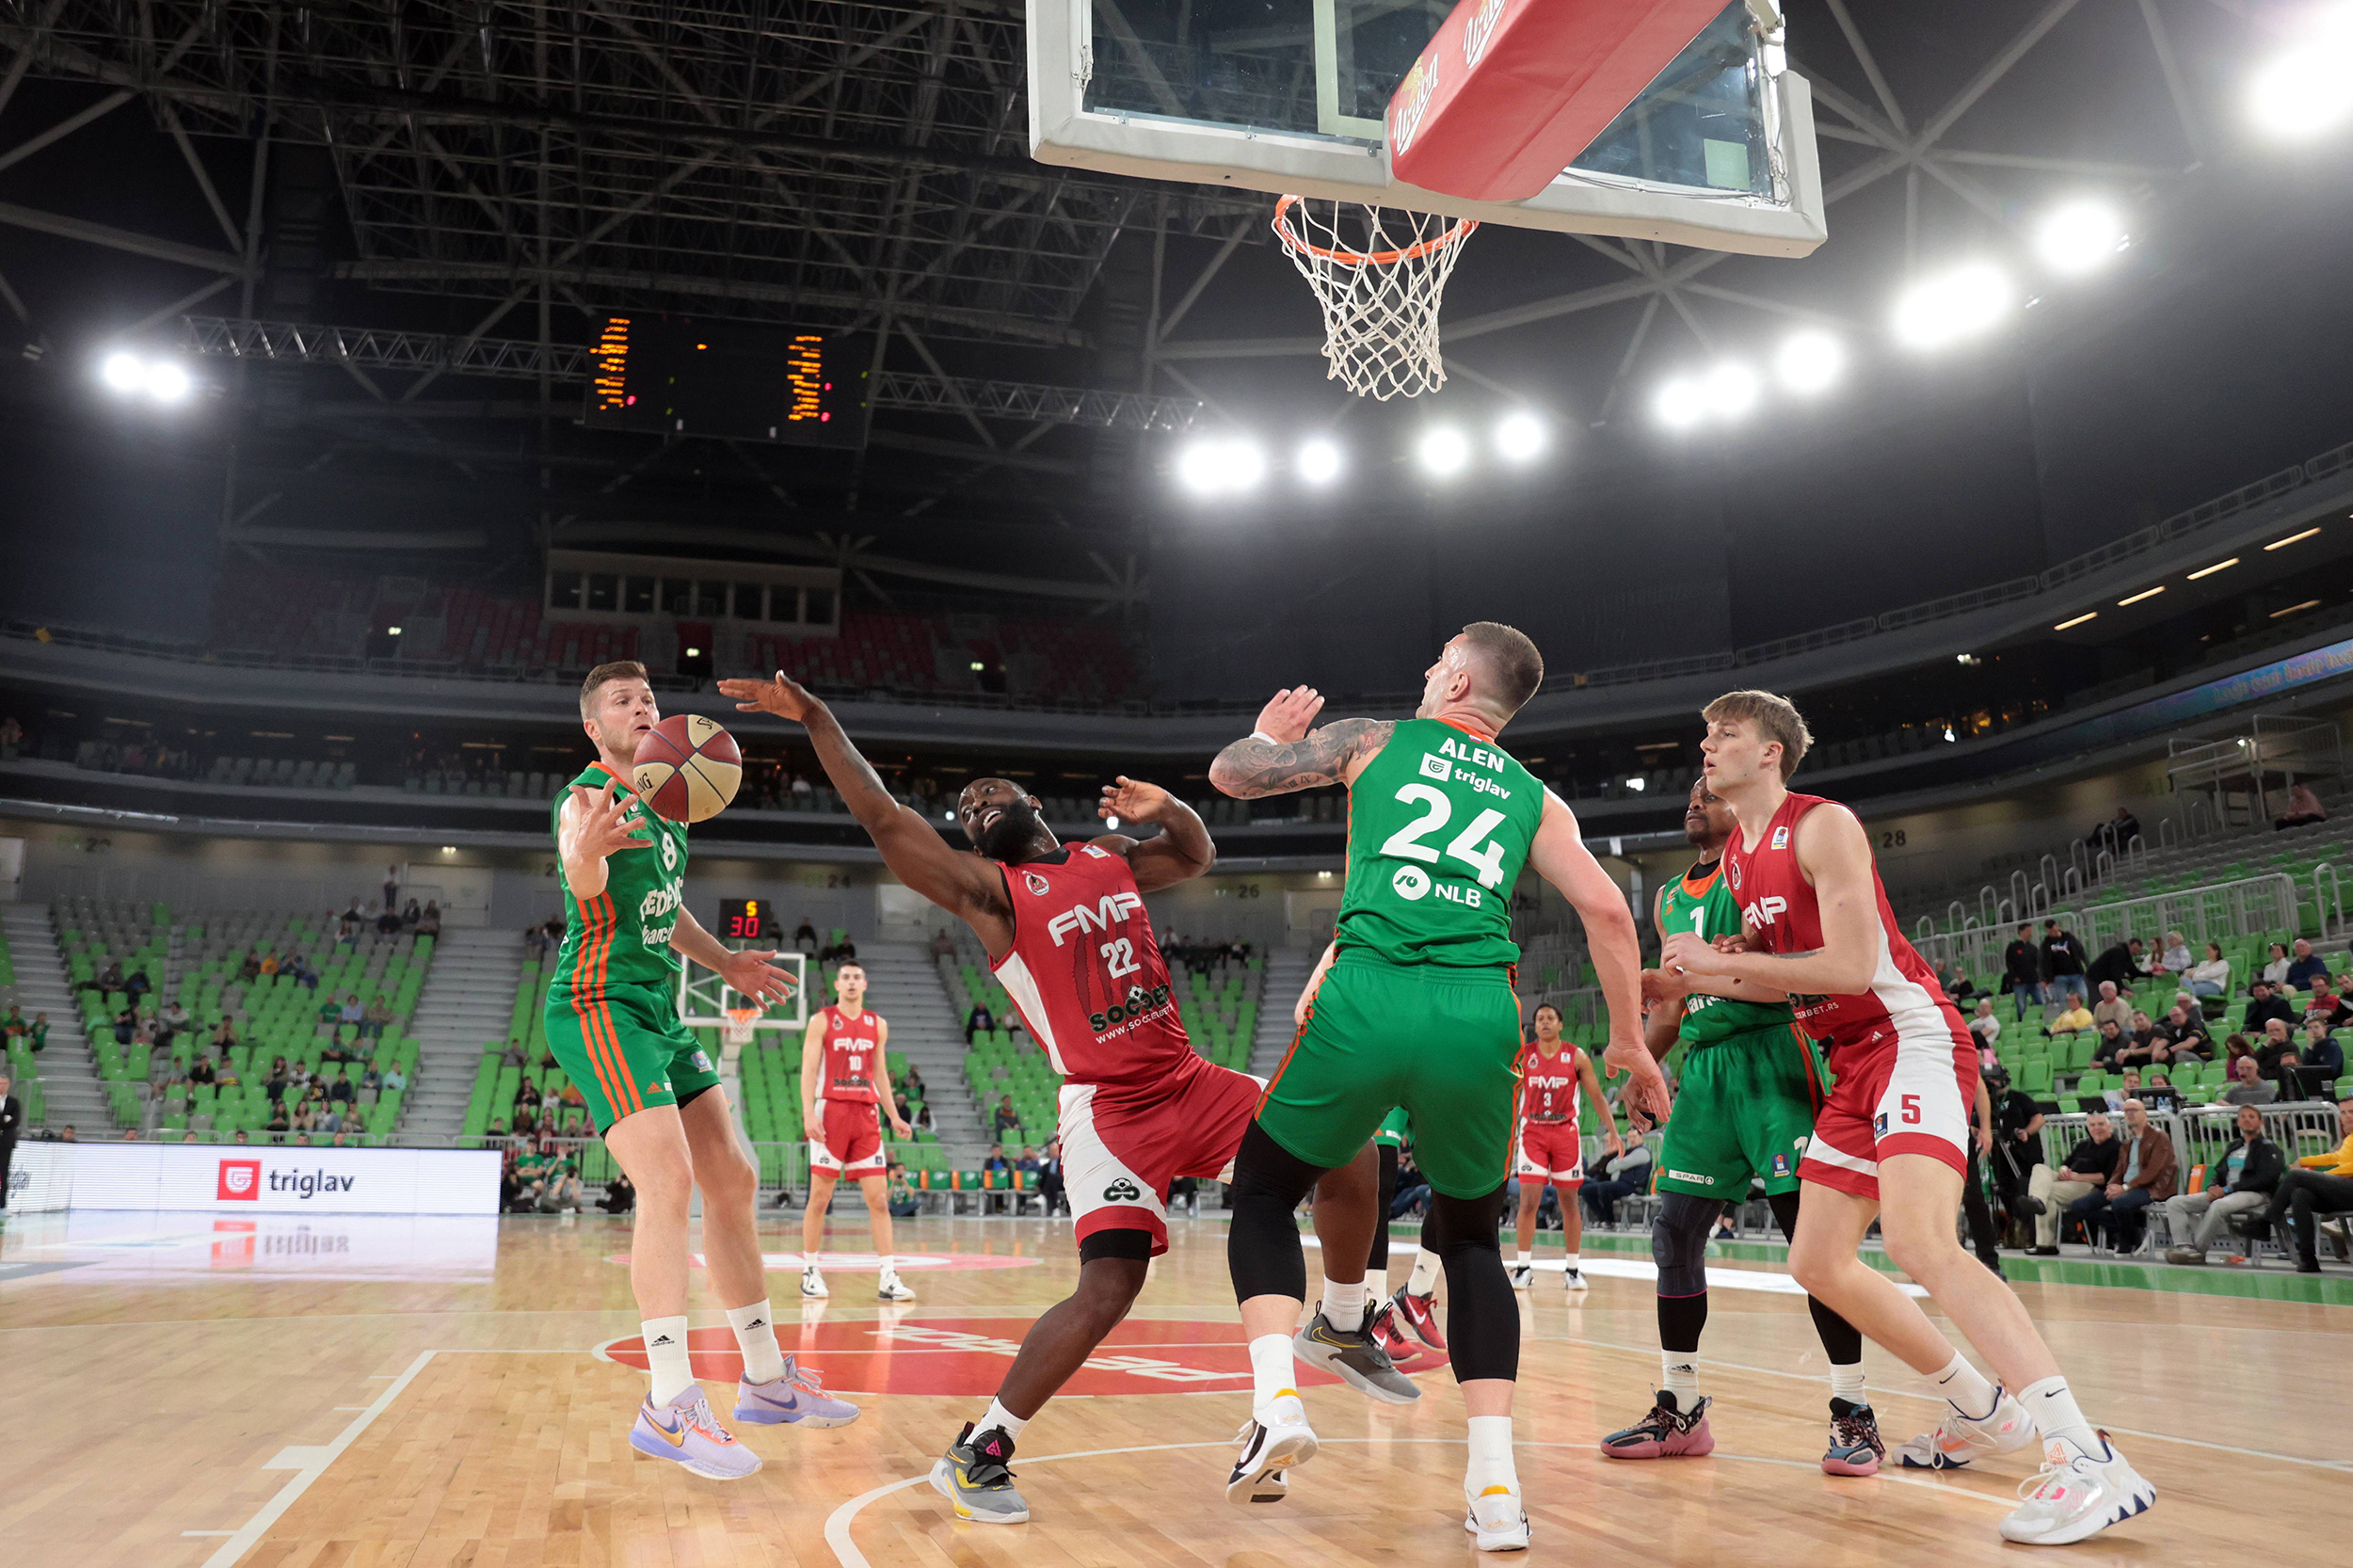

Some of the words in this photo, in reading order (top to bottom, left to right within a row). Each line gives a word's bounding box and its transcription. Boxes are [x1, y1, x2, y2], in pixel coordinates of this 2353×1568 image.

[1438, 737, 1504, 773] ALEN
[1454, 768, 1512, 800] triglav
[1379, 782, 1507, 890] 24
[1882, 830, 1907, 848] 28
[662, 832, 678, 871] 8
[1238, 884, 1260, 899] 26
[1434, 883, 1481, 908] NLB
[728, 916, 760, 938] 30
[1048, 891, 1142, 947] FMP
[1689, 905, 1705, 939] 1
[1100, 937, 1141, 979] 22
[833, 1036, 874, 1052] FMP
[848, 1055, 862, 1071] 10
[1528, 1075, 1569, 1090] FMP
[1544, 1092, 1552, 1108] 3
[1901, 1094, 1921, 1125] 5
[269, 1167, 356, 1199] triglav
[1675, 1172, 1704, 1182] SPAR
